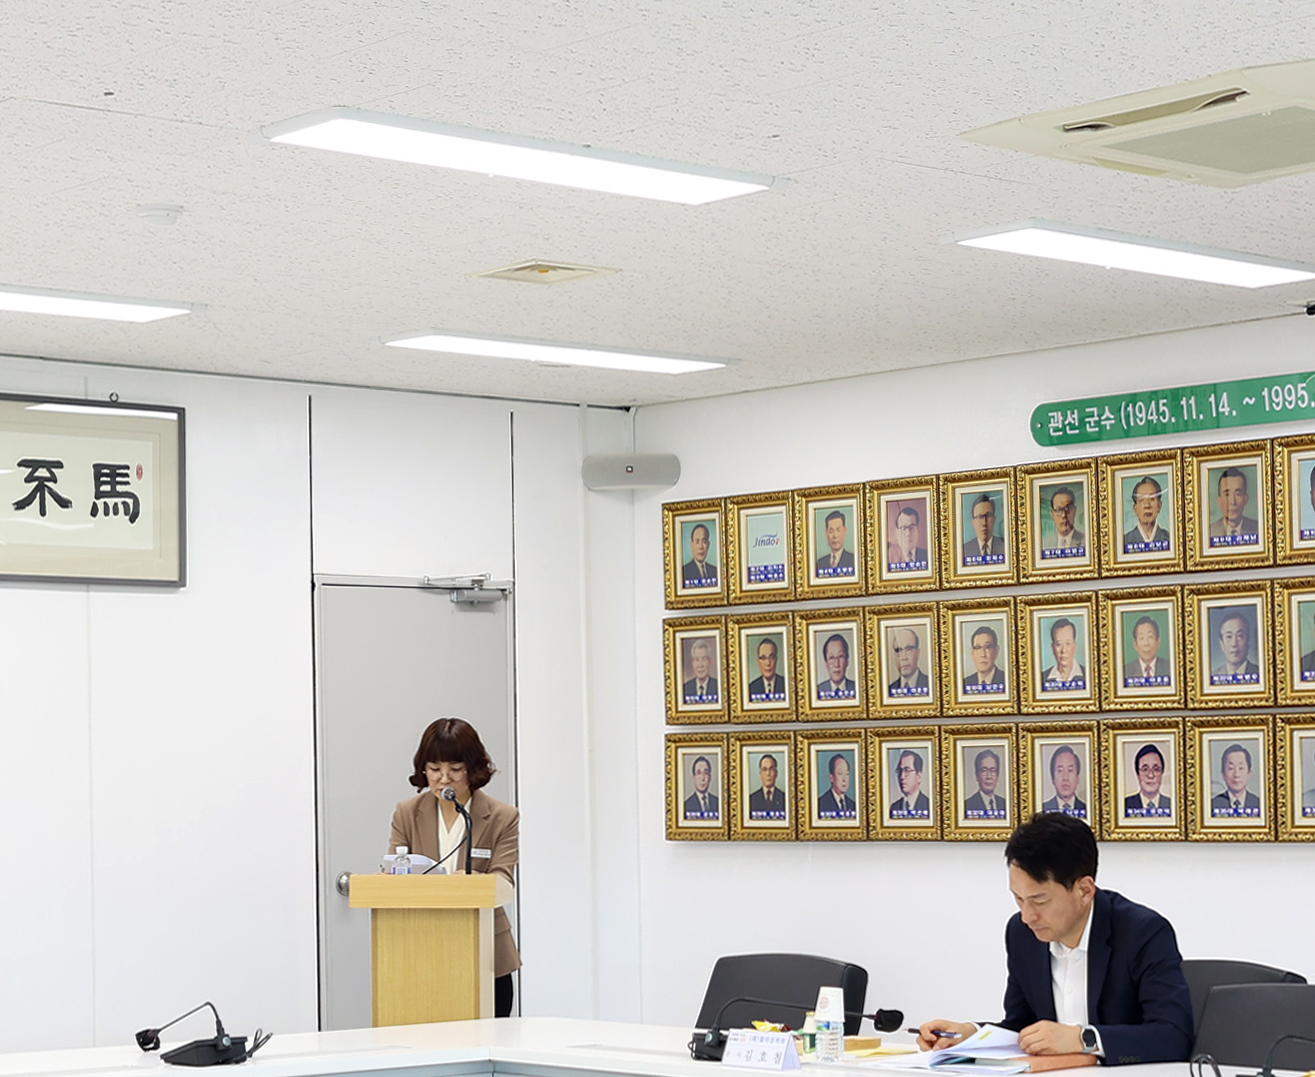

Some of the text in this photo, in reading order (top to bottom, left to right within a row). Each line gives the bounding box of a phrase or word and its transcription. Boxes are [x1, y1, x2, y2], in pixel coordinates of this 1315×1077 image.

[1048, 411, 1080, 436] 관선
[1085, 406, 1115, 432] 군수
[1120, 399, 1176, 430] (1945.
[1181, 397, 1204, 421] 11.
[1209, 392, 1237, 417] 14.
[1262, 384, 1315, 412] 1995.
